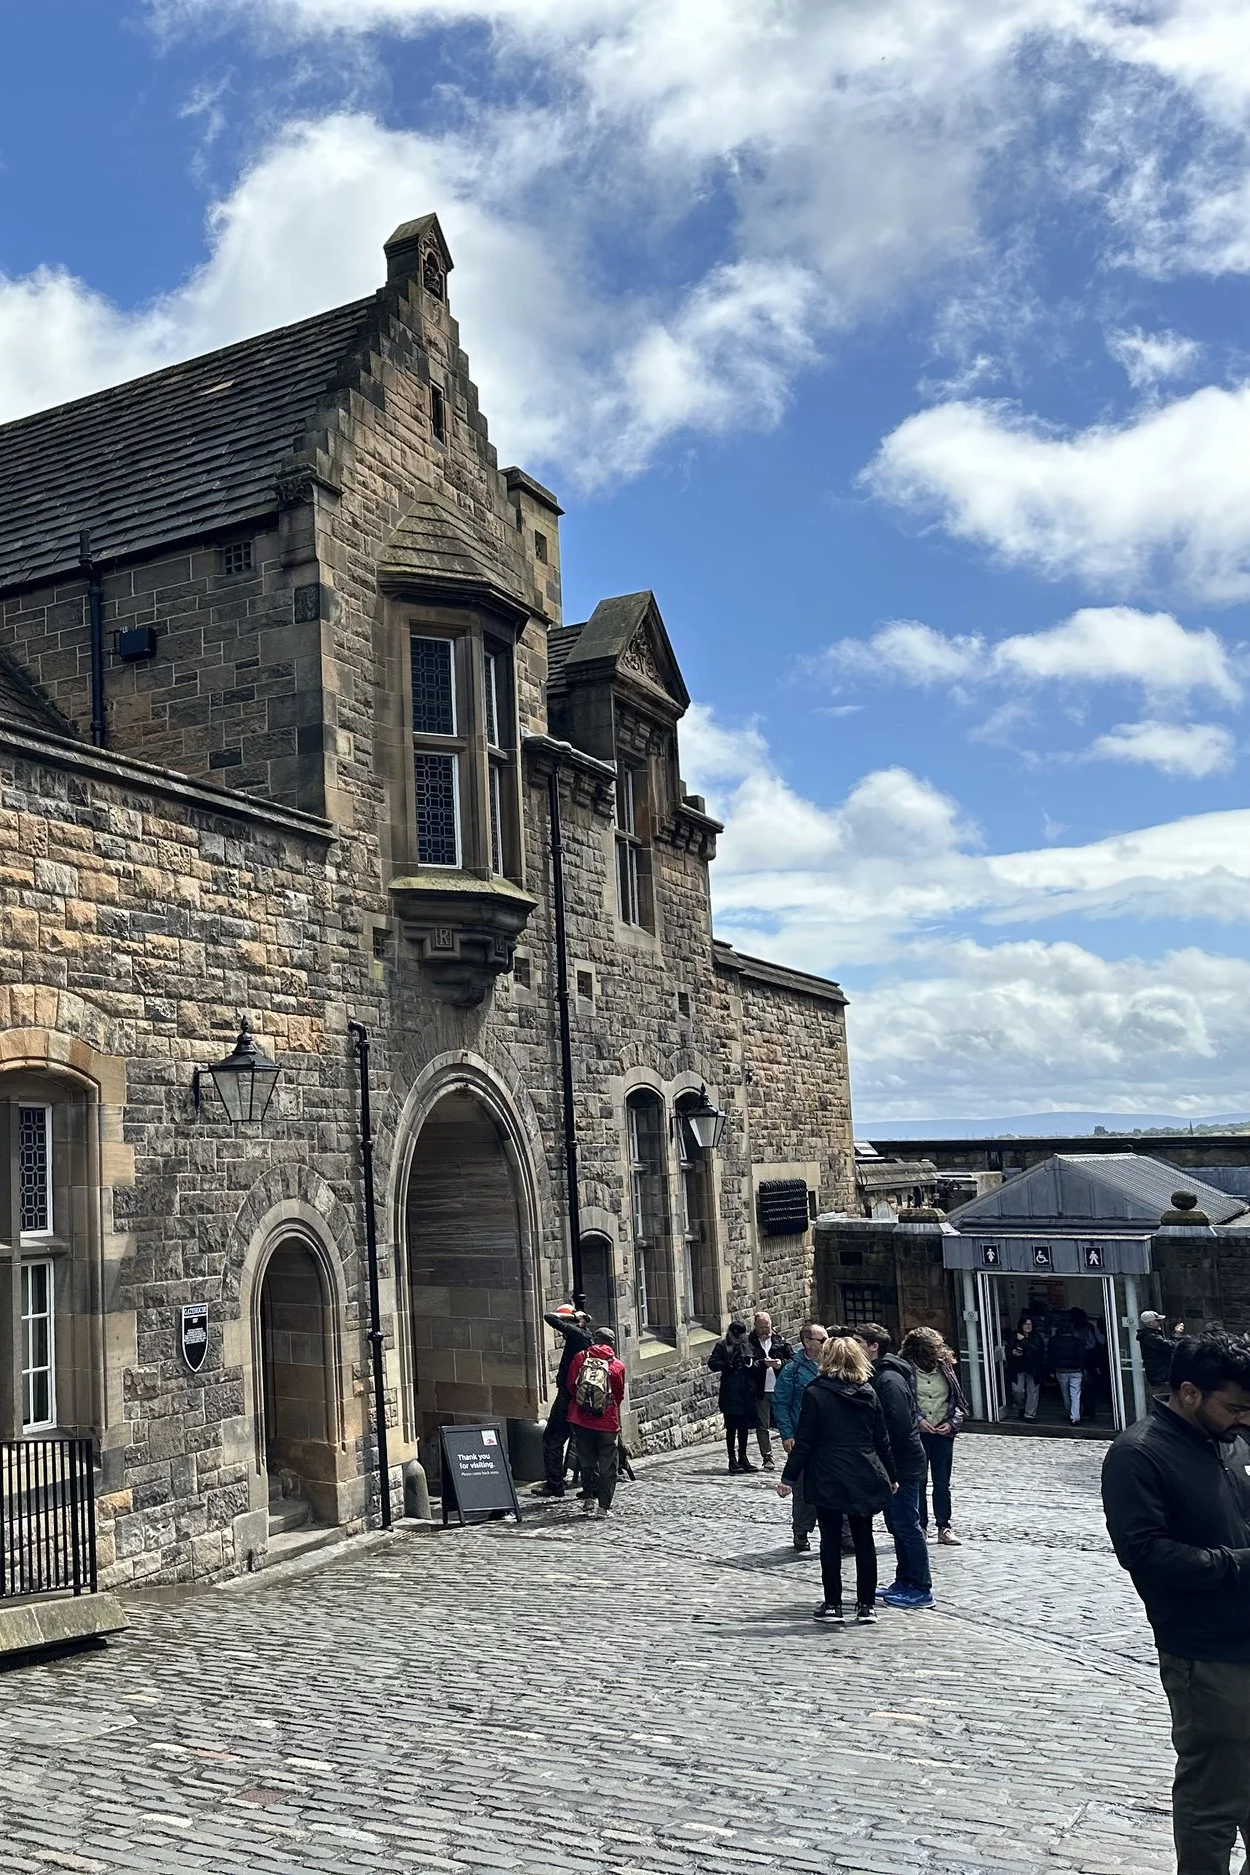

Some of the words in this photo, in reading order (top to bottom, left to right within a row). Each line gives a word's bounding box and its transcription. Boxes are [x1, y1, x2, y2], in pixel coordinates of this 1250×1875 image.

[439, 928, 449, 945] R
[457, 1453, 478, 1461] Thank
[478, 1453, 490, 1461] you
[470, 1461, 495, 1469] visiting.
